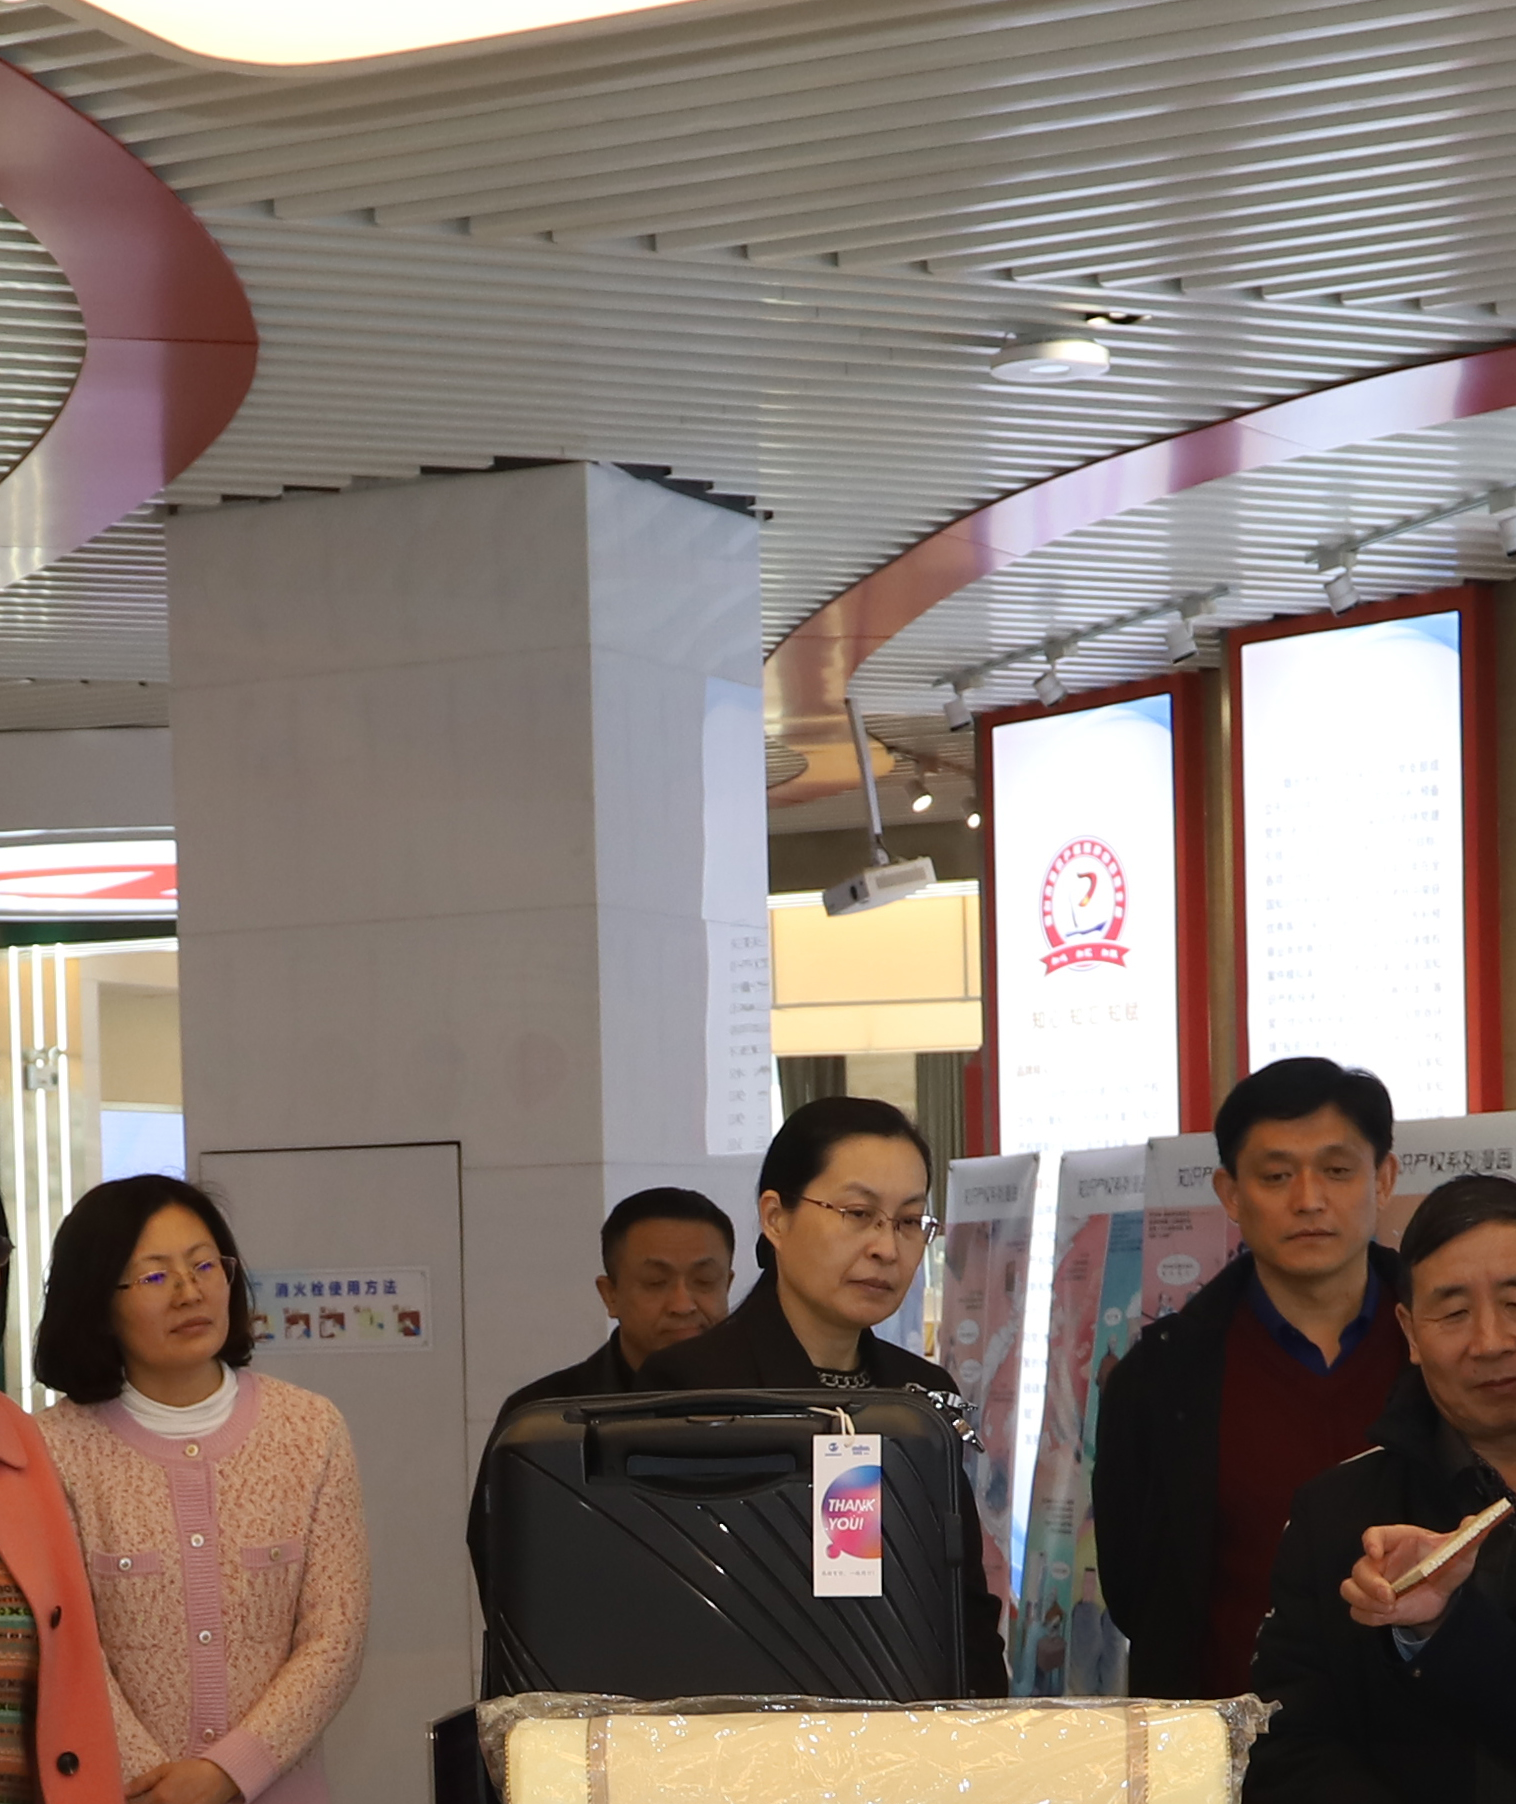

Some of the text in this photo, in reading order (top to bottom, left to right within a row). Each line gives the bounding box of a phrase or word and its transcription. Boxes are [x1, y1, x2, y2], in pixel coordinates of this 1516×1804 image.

[275, 1279, 398, 1298] 消火栓使用方法
[827, 1499, 876, 1512] THANK
[827, 1517, 865, 1531] YOU!
